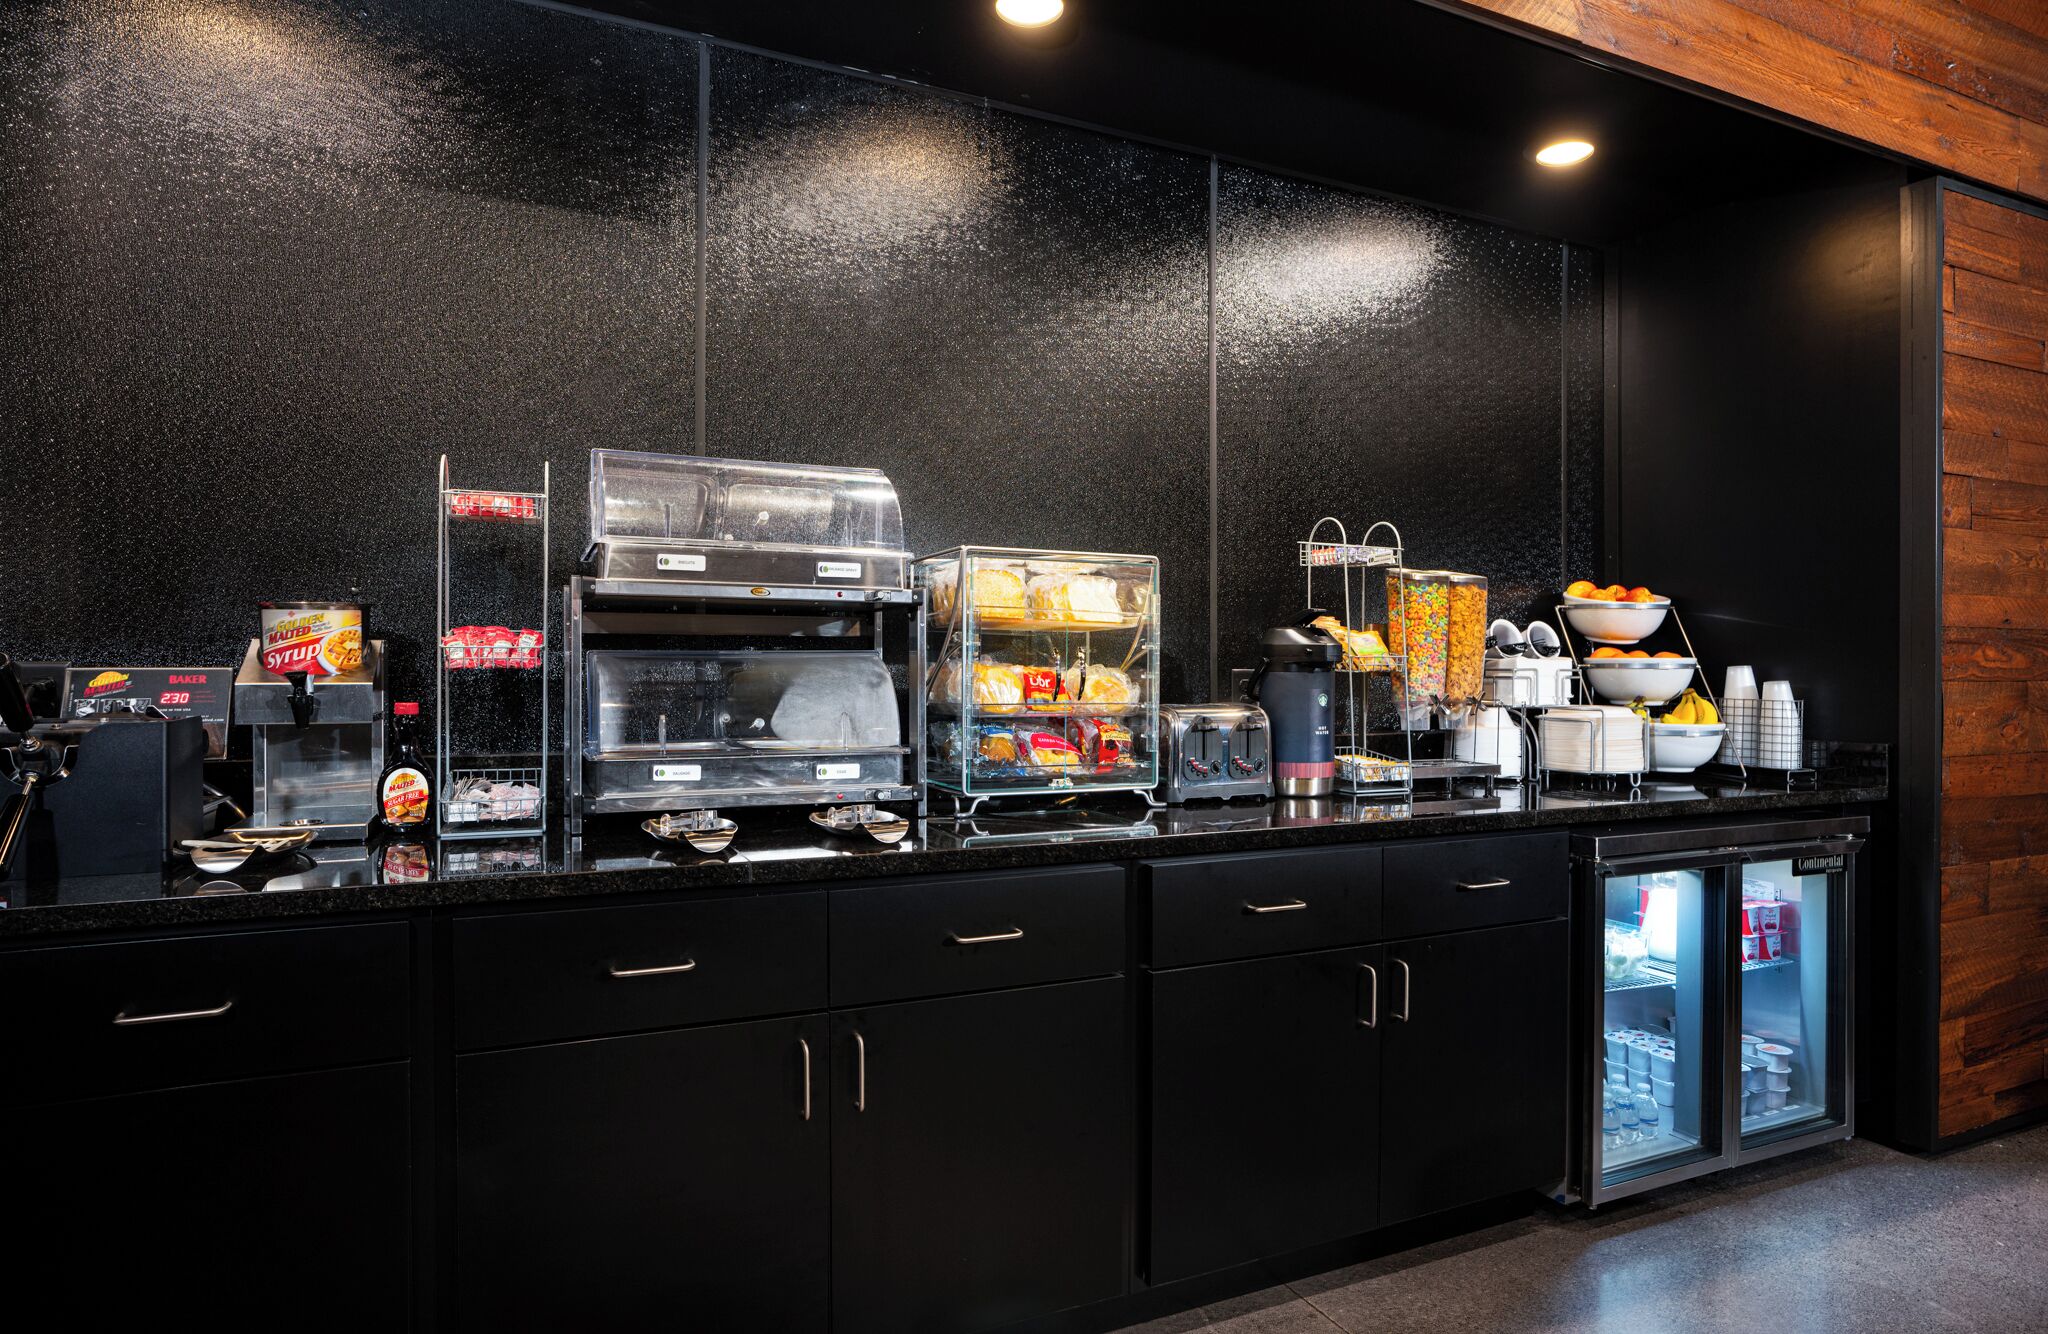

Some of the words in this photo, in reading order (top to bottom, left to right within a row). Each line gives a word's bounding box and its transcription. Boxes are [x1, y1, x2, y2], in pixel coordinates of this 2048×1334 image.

[277, 613, 324, 632] GOLDEN
[268, 625, 311, 644] MALTED
[267, 644, 320, 668] Syrup
[169, 675, 207, 684] BAKER
[388, 797, 404, 806] SUGAR
[405, 792, 419, 800] FREE
[1798, 854, 1843, 870] Continental
